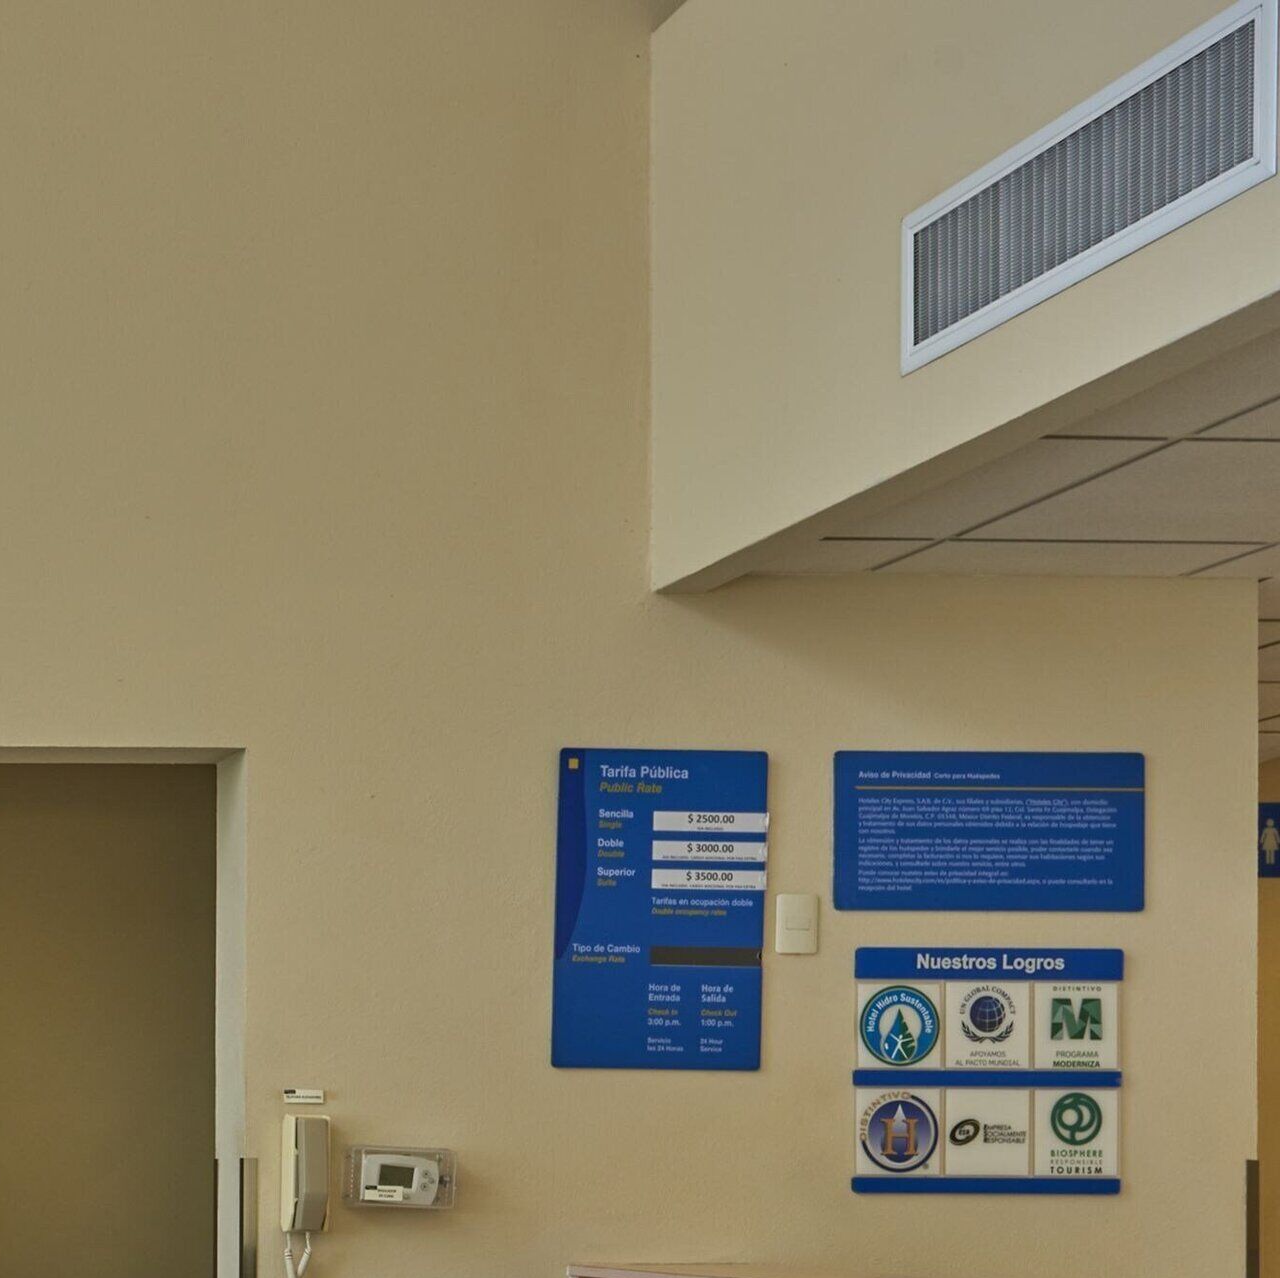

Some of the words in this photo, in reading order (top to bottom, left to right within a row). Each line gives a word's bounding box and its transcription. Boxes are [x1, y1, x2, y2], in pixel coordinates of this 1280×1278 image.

[600, 765, 636, 779] Tarifa
[640, 766, 689, 779] Pública
[858, 771, 880, 779] Aviso
[881, 771, 891, 779] de
[892, 771, 931, 779] Privacidad
[600, 781, 633, 793] Public
[636, 783, 662, 793] Rate
[598, 809, 634, 818] Sencilla
[688, 813, 694, 824] $
[696, 815, 735, 824] 2500.00
[597, 838, 624, 847] Doble
[687, 842, 693, 853] $
[696, 844, 734, 853] 3000.00
[597, 867, 636, 877] Superior
[686, 871, 692, 881] $
[695, 872, 733, 881] 3500.00
[652, 897, 677, 905] Tarifas
[690, 899, 729, 908] ocupación
[572, 943, 592, 953] Tipo
[593, 944, 605, 952] de
[606, 944, 641, 953] Cambio
[916, 953, 997, 970] Nuestros
[1002, 954, 1065, 974] Logros
[648, 984, 668, 992] Hora
[670, 984, 681, 992] de
[701, 984, 721, 992] Hora
[723, 985, 734, 993] de
[648, 993, 681, 1002] Entrada
[701, 994, 726, 1002] Salida
[965, 985, 991, 1002] GLOBAL
[991, 986, 1016, 1014] COMPACT
[867, 1009, 880, 1032] Hotel
[876, 995, 899, 1010] Hidro
[900, 993, 934, 1034] Sustentable
[1050, 1166, 1103, 1174] TOURISM
